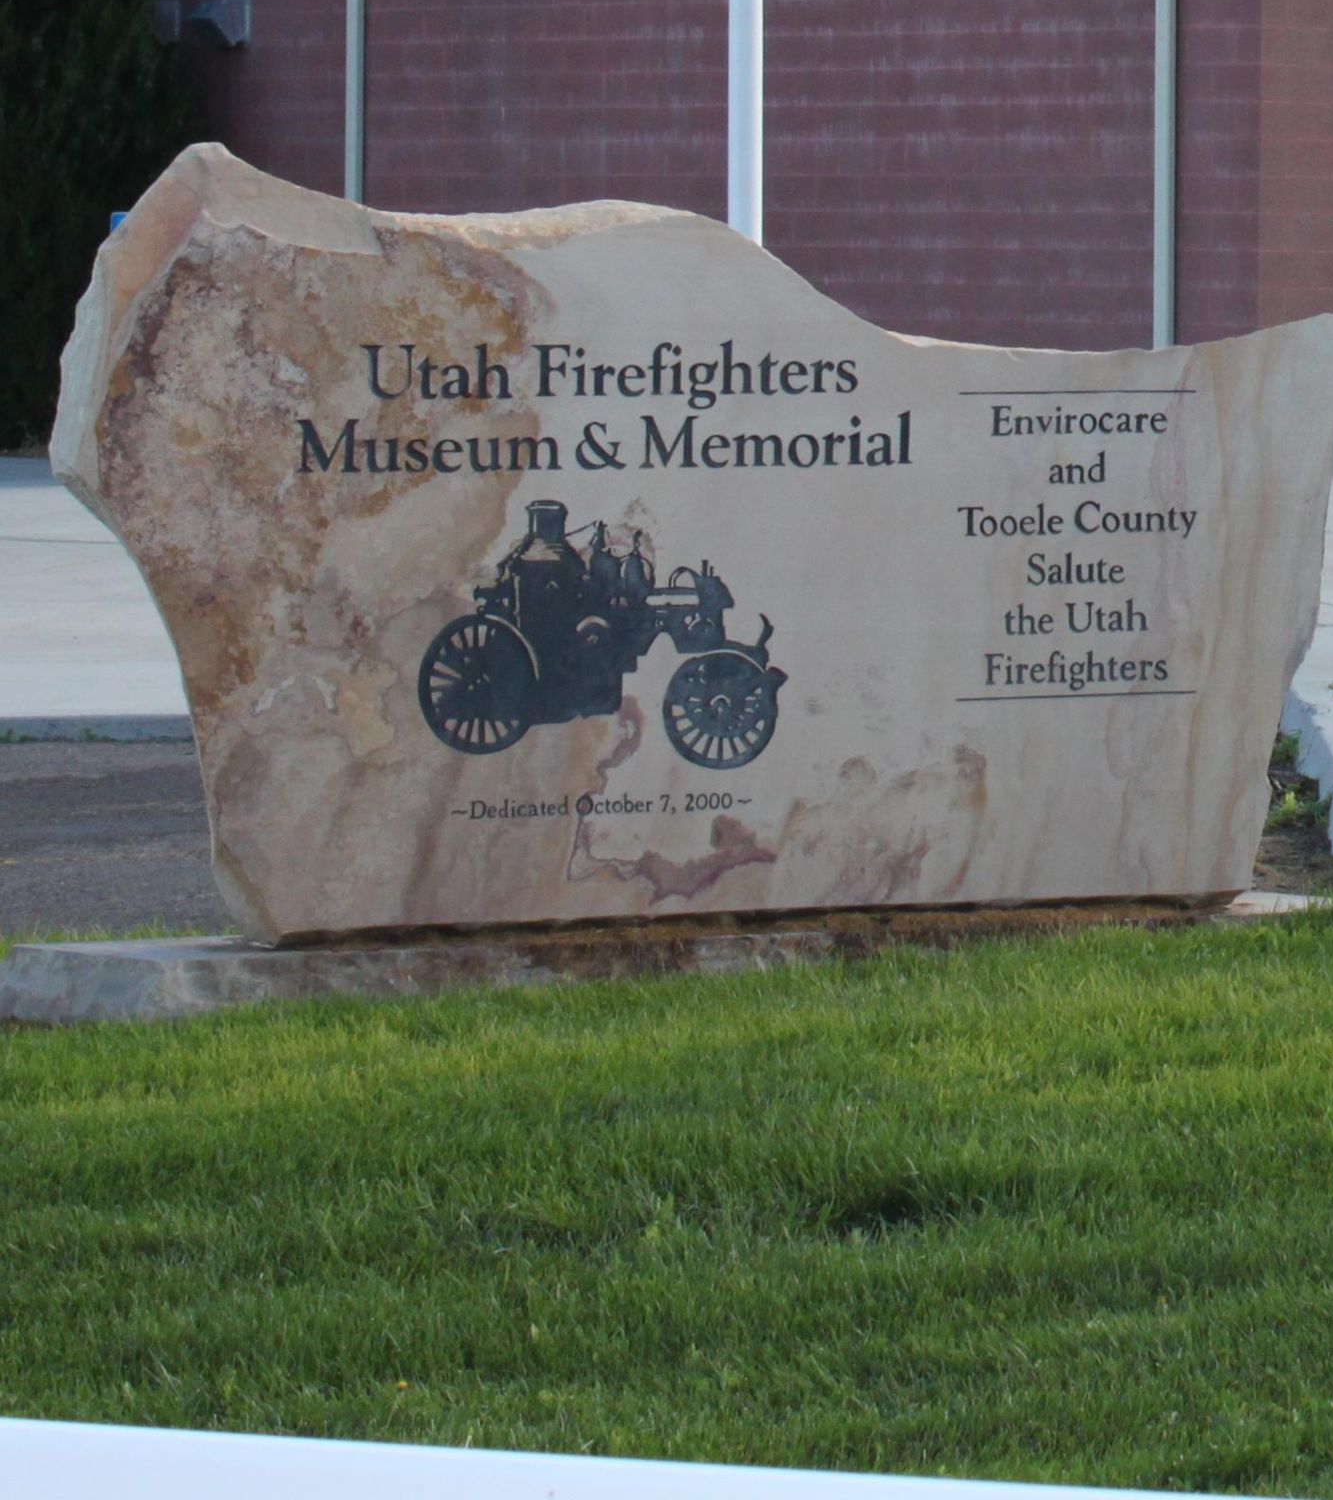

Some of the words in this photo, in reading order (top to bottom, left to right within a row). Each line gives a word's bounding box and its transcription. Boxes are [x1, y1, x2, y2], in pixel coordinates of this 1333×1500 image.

[361, 344, 511, 400] Utah
[532, 339, 859, 409] Firefighters
[991, 404, 1168, 437] Envirocare
[297, 418, 562, 474] Museum
[576, 421, 626, 471] &
[640, 410, 912, 468] Memorial
[1048, 451, 1106, 485] and
[957, 503, 1064, 537] Tooele
[1074, 501, 1198, 539] County
[1026, 552, 1126, 586] Salute
[1004, 604, 1054, 636] the
[1065, 599, 1149, 633] Utah
[984, 651, 1169, 691] Firefighters
[575, 793, 653, 818] October
[659, 794, 677, 815] 7,
